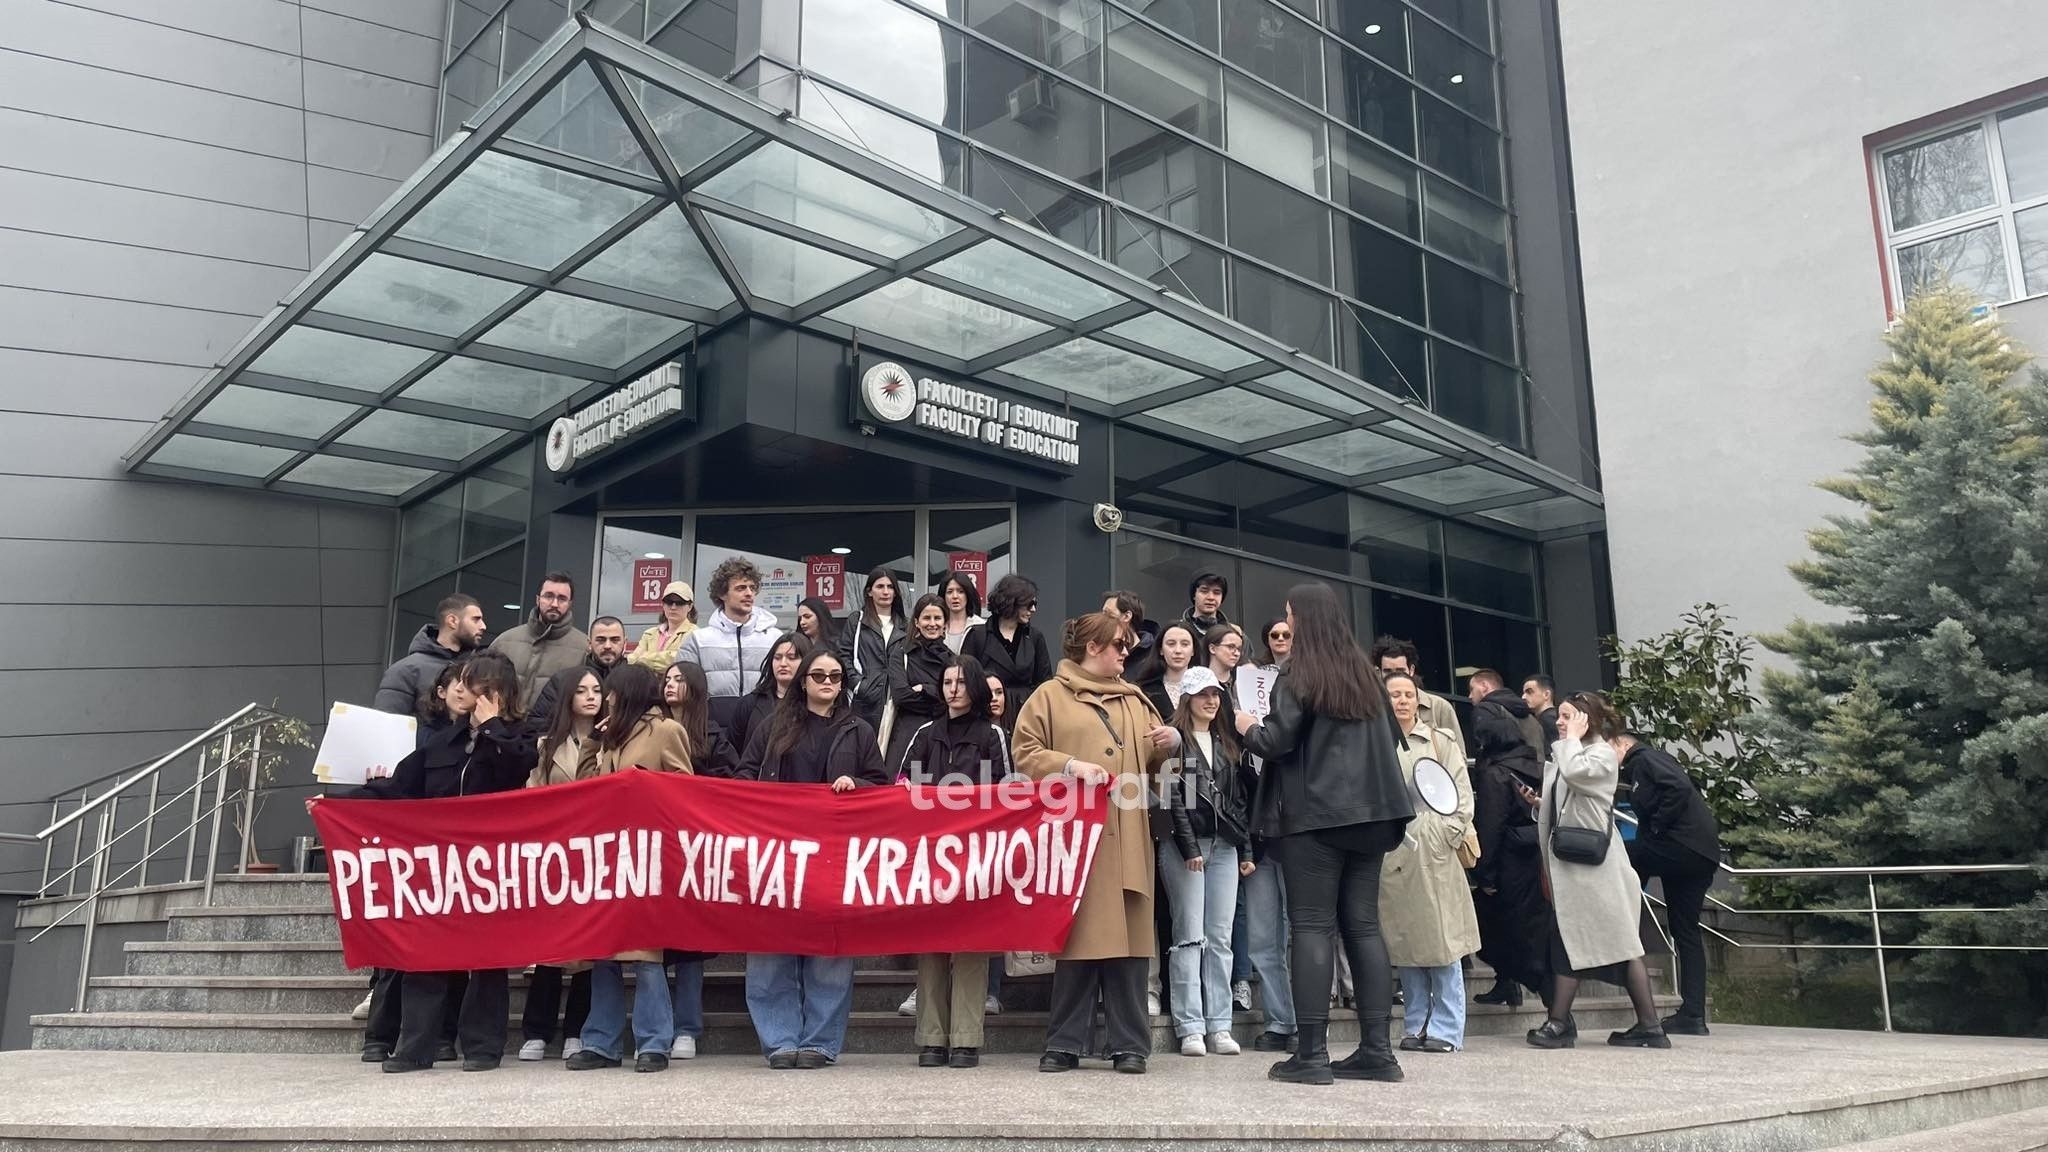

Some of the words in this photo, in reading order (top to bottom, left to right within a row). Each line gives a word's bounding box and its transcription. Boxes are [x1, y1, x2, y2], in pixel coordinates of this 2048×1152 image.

[919, 377, 998, 419] FAKULTETI
[1013, 404, 1079, 441] EDUKIMIT
[919, 402, 981, 438] FACULTY
[984, 421, 1005, 444] OF
[1009, 427, 1079, 465] EDUCATION
[642, 579, 661, 601] 13
[815, 576, 835, 597] 13
[331, 829, 663, 921] PËRJASHTOJENI
[677, 829, 820, 910] XHEVAT
[842, 820, 1103, 917] KRASNIQIN!
